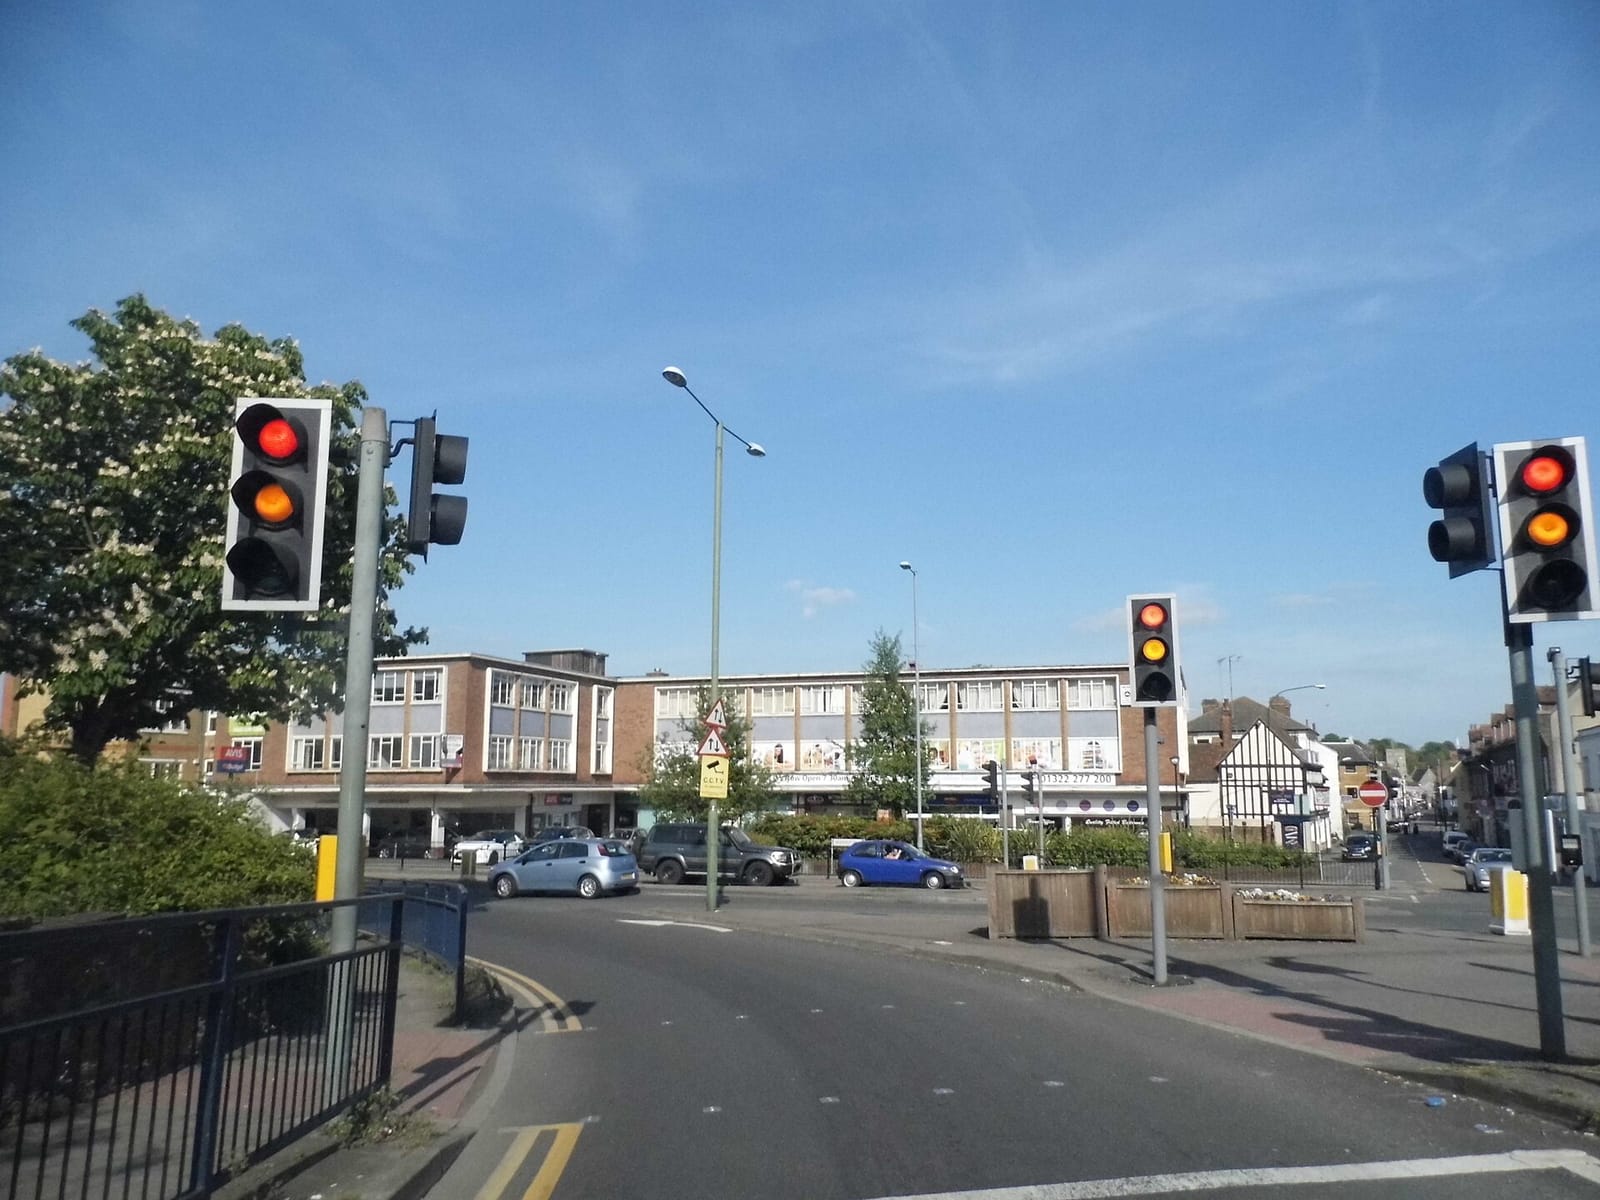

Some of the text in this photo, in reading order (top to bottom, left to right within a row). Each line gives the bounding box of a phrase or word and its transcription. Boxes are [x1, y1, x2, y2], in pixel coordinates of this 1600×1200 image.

[225, 748, 243, 758] AVIS
[802, 774, 821, 783] Open
[1073, 774, 1090, 783] 277
[1094, 774, 1112, 783] 200
